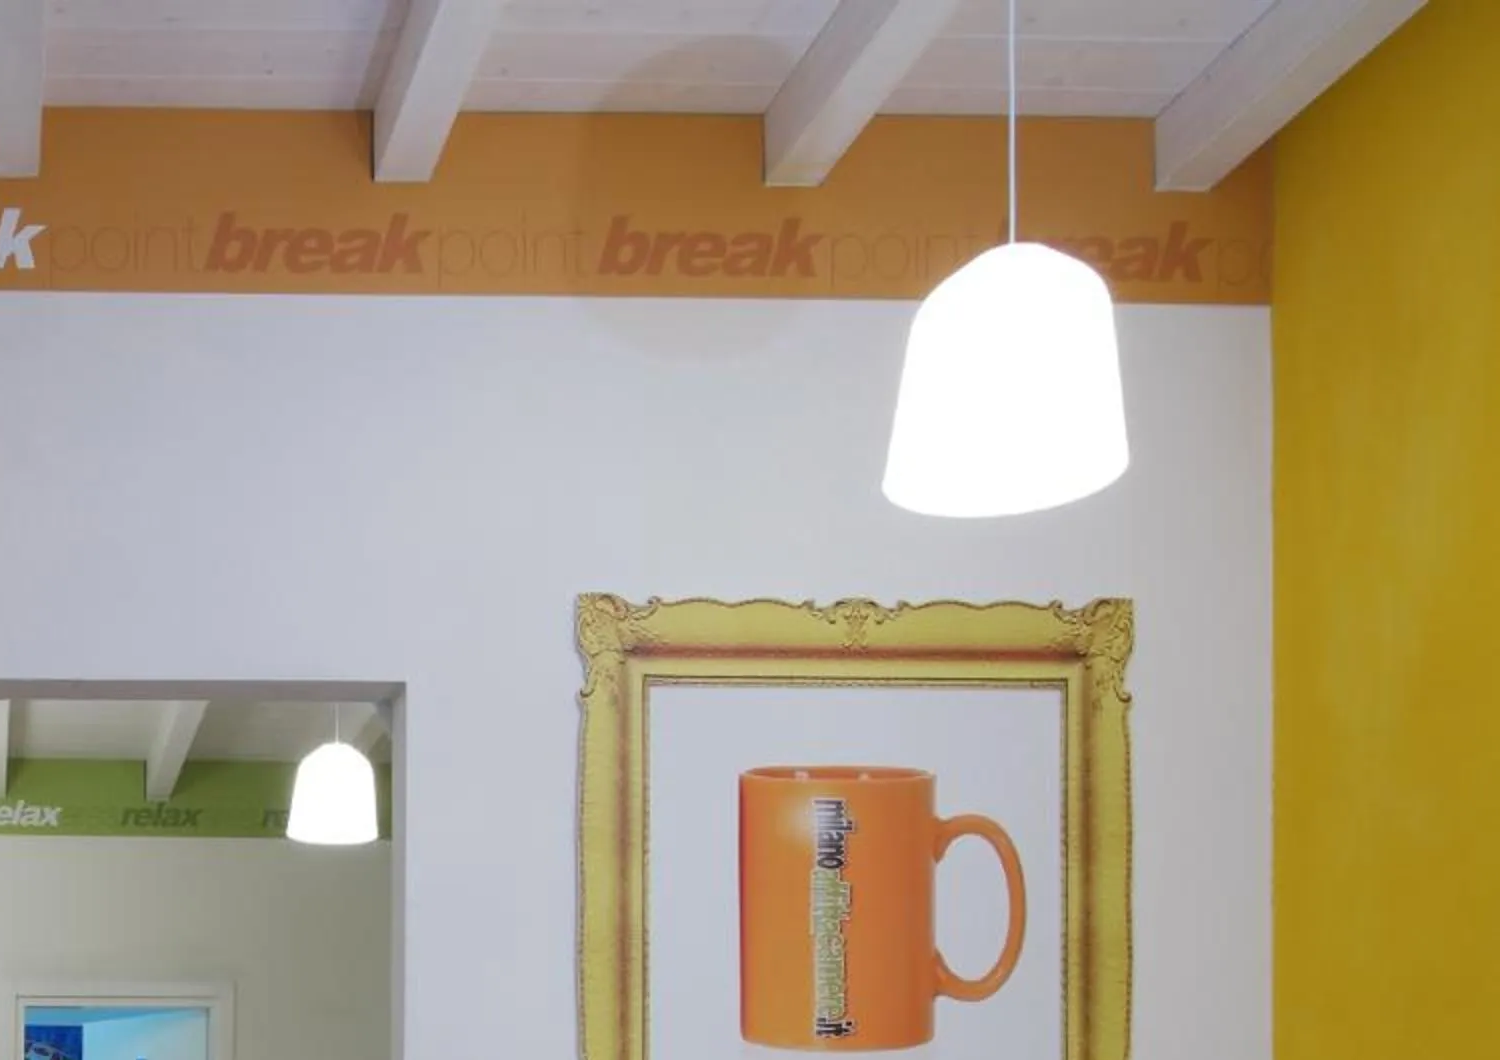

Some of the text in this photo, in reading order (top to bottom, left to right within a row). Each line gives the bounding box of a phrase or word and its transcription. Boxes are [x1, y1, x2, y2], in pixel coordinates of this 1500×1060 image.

[47, 210, 202, 288] point
[203, 210, 431, 275] break
[435, 209, 589, 290] point
[596, 213, 824, 278] break
[121, 800, 204, 829] relax
